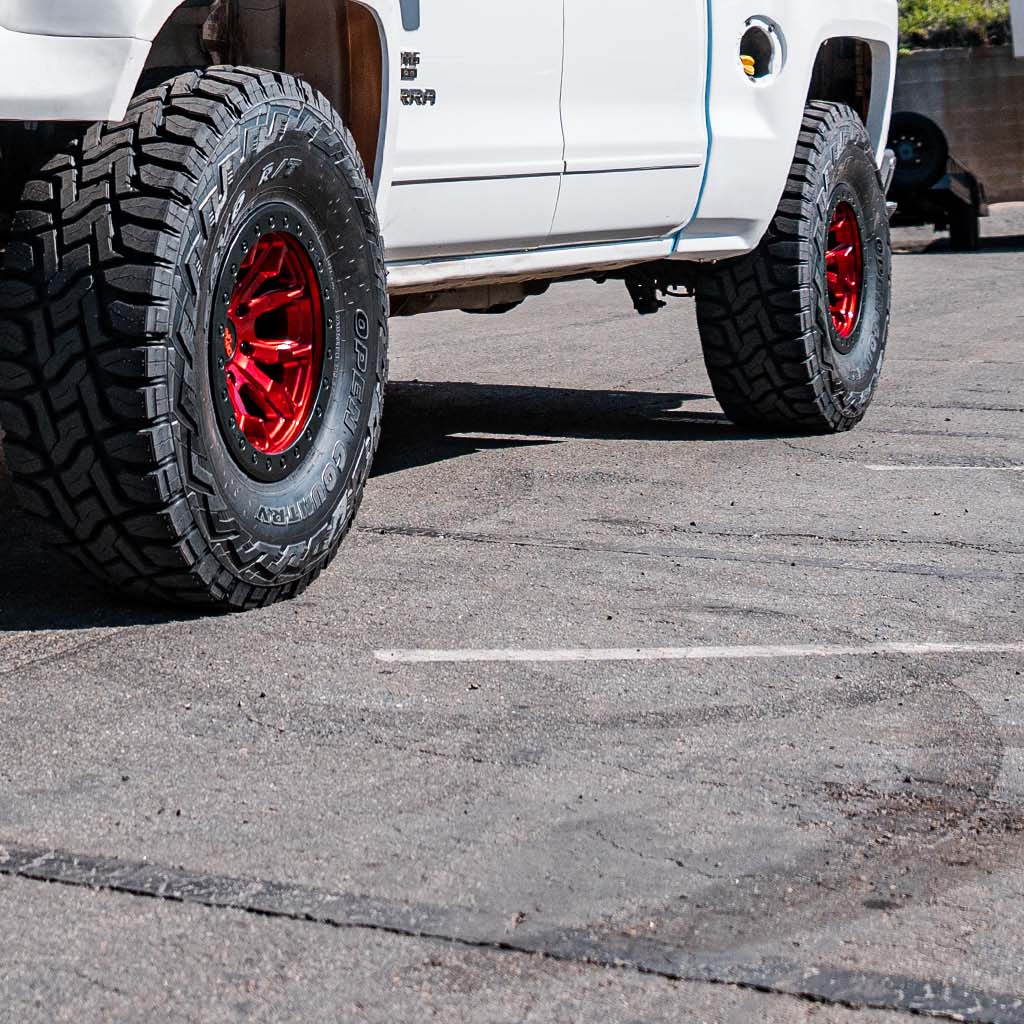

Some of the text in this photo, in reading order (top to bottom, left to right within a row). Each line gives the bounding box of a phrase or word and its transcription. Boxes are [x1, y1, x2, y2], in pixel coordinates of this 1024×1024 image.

[257, 157, 304, 186] R/T
[343, 308, 369, 436] OPEN
[255, 439, 347, 526] COUNTRY
